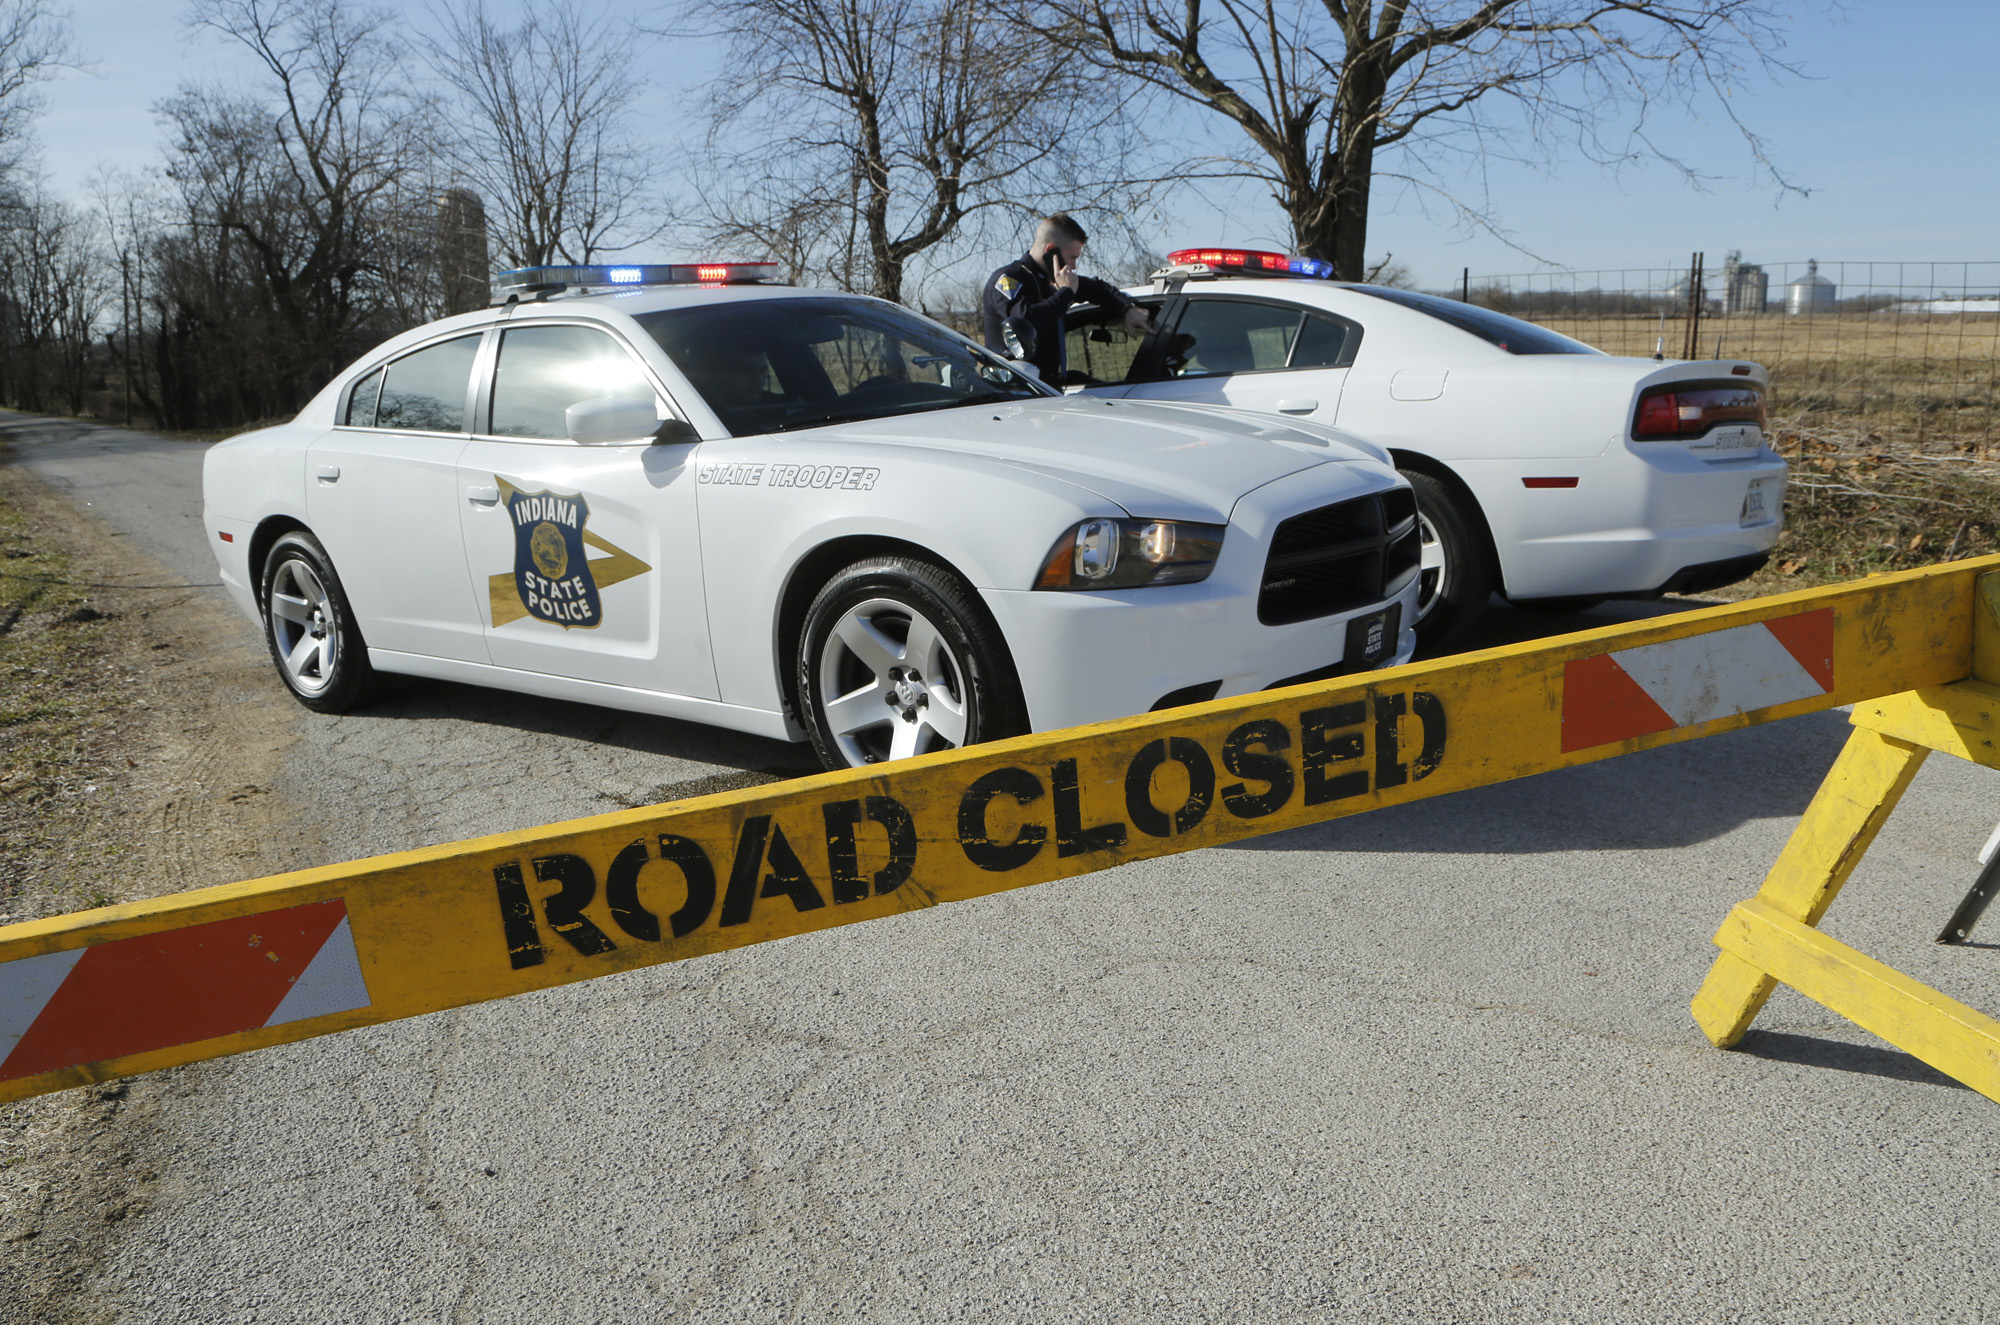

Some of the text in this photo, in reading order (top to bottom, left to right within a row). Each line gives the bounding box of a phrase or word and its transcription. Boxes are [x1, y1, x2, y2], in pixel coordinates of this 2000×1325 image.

[698, 463, 881, 491] STATE TROOPER
[515, 497, 577, 530] INDIANA
[525, 571, 586, 599] STATE
[528, 590, 593, 620] POLICE
[1365, 640, 1382, 655] POLICE
[1367, 631, 1382, 645] STATE
[492, 795, 917, 971] ROAD
[957, 691, 1448, 873] CLOSED
